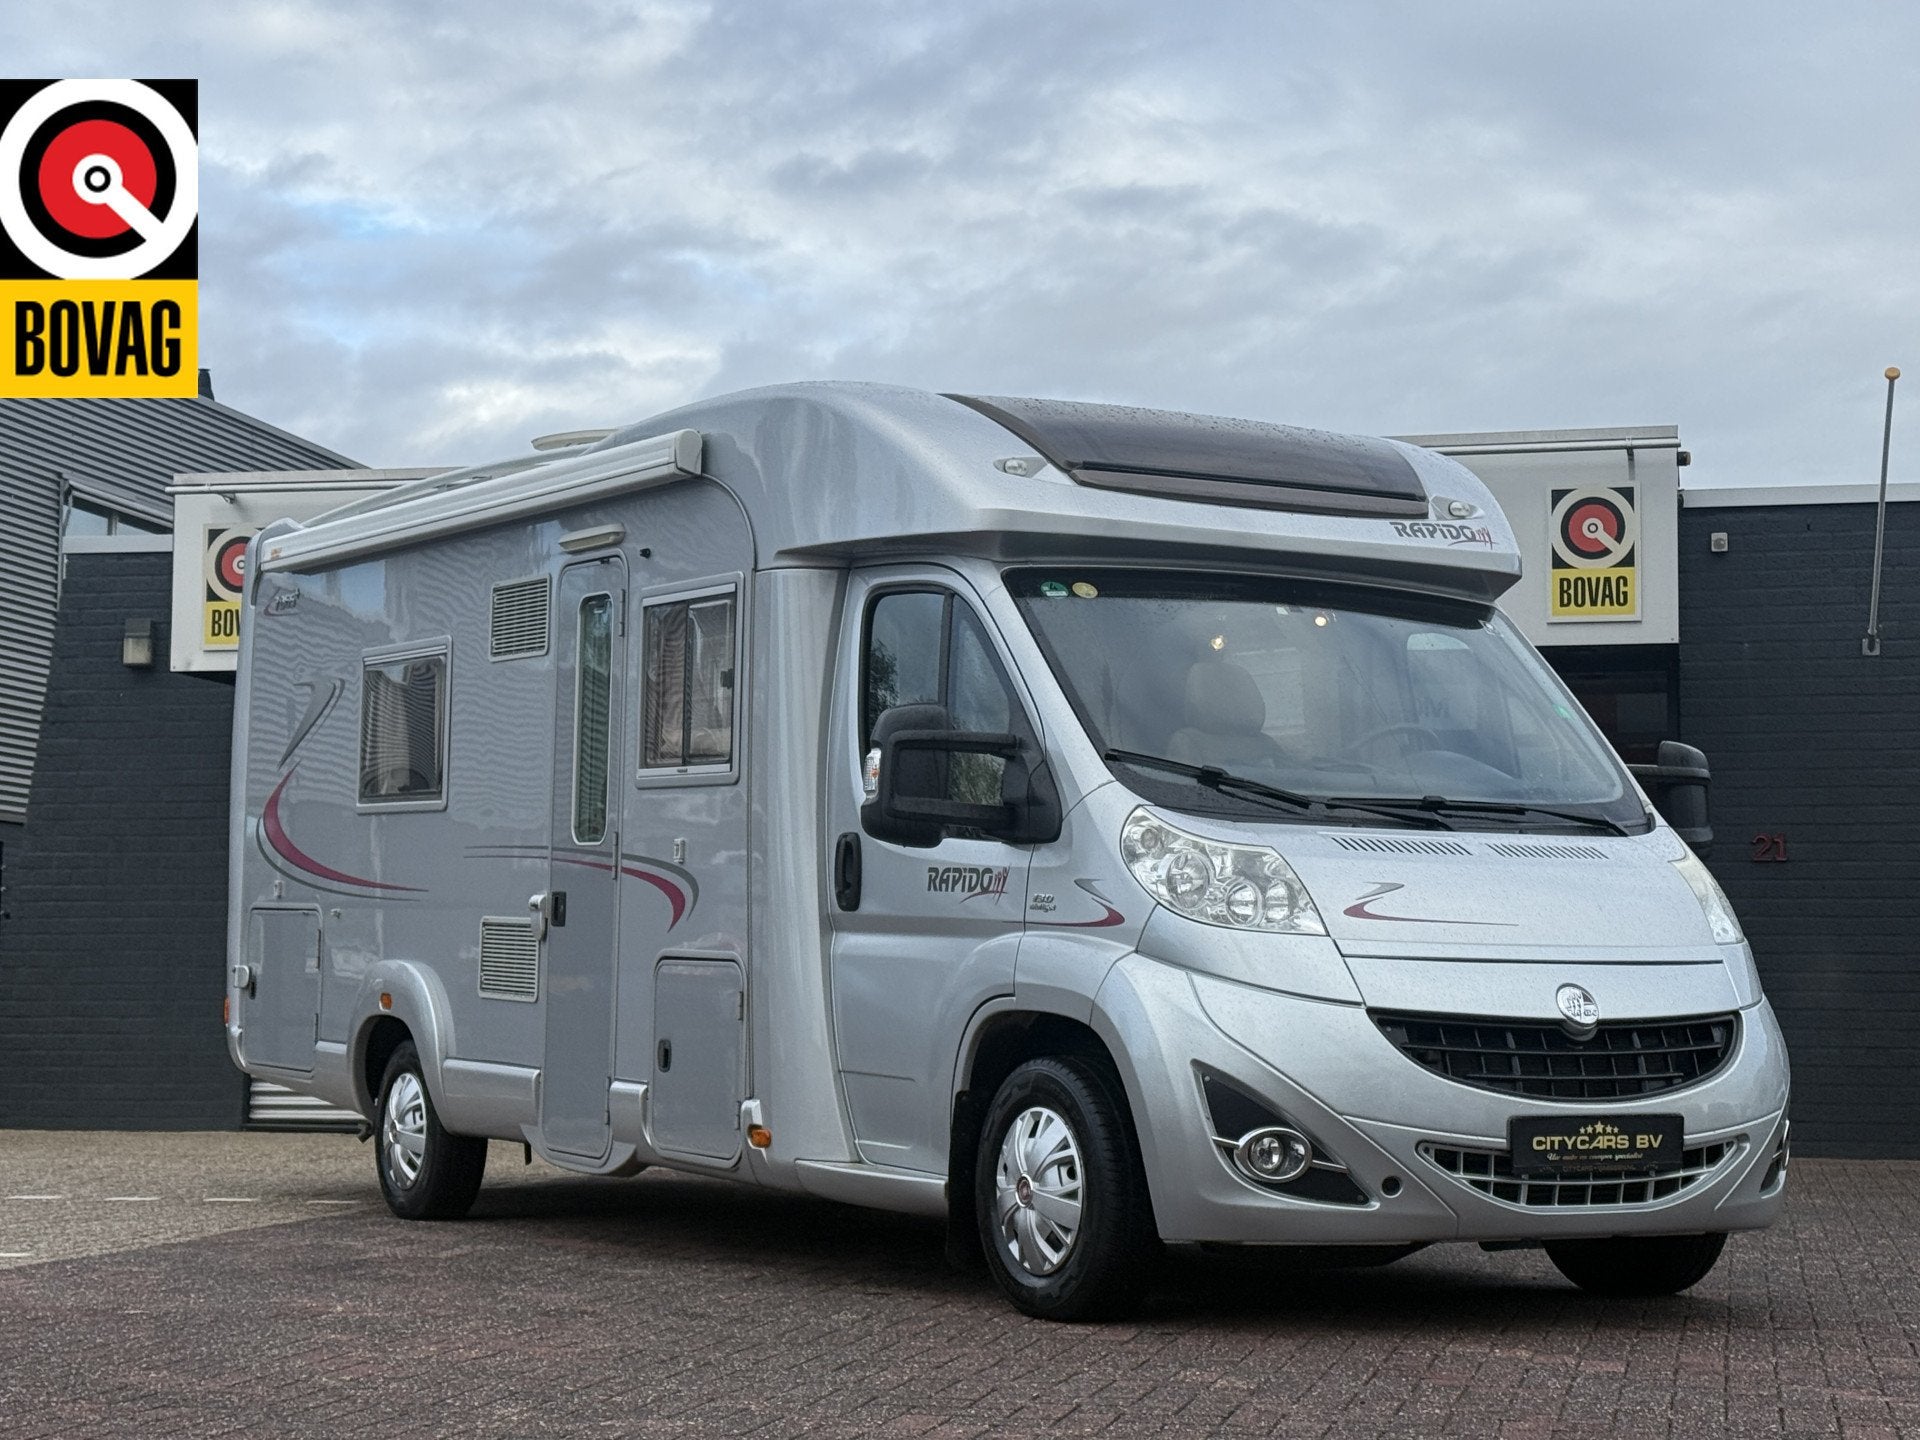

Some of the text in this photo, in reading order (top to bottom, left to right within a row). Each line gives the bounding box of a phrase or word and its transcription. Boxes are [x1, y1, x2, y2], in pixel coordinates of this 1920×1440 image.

[1559, 575, 1629, 608] BOVAG
[1752, 832, 1788, 862] 21
[1532, 1134, 1663, 1151] CITYCARS BV
